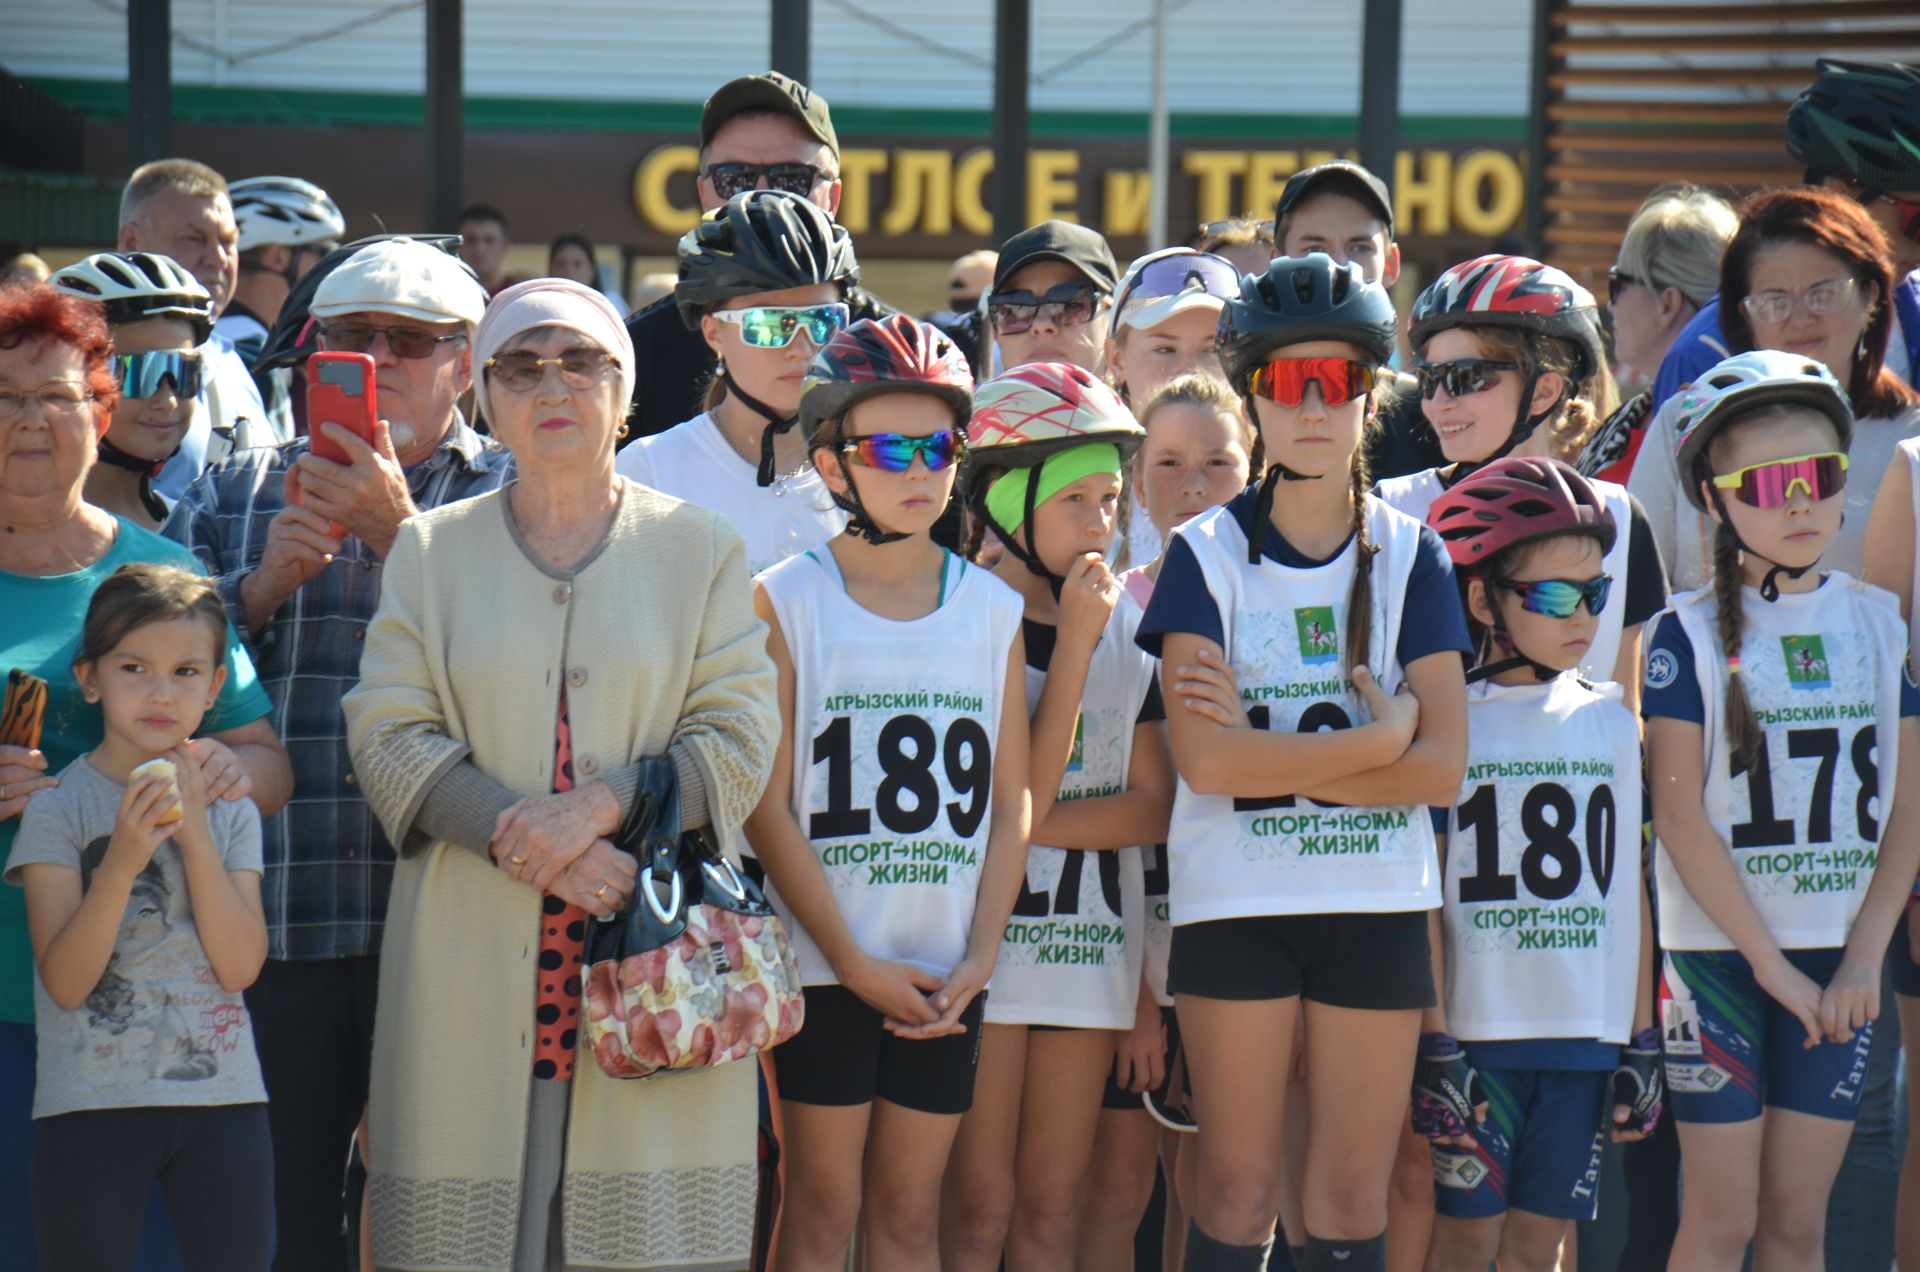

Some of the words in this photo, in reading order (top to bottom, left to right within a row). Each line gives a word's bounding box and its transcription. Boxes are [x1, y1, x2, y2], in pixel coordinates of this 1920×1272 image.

[1244, 675, 1341, 700] АГРЫЗСКИЙ
[824, 689, 928, 711] АГРЫЗСКИЙ
[934, 691, 983, 712] РАЙОН
[1754, 701, 1836, 724] РЫЗСКИЙ
[809, 714, 992, 840] 189
[1467, 758, 1567, 780] АГРЫЗСКИЙ
[1572, 759, 1614, 778] РАЙОН
[1251, 815, 1322, 836] СПОРТ
[822, 841, 894, 866] СПОРТ
[911, 841, 977, 866] НОРМА
[1298, 834, 1380, 855] ЖИЗНИ
[1457, 781, 1617, 904] 180
[868, 863, 948, 885] ЖИЗНИ
[1746, 852, 1815, 874] СПОРТ
[1473, 907, 1541, 929] СПОРТ
[1517, 928, 1598, 950] ЖИЗНИ
[1035, 944, 1104, 965] ЖИЗНИ
[171, 1032, 241, 1056] MEOW
